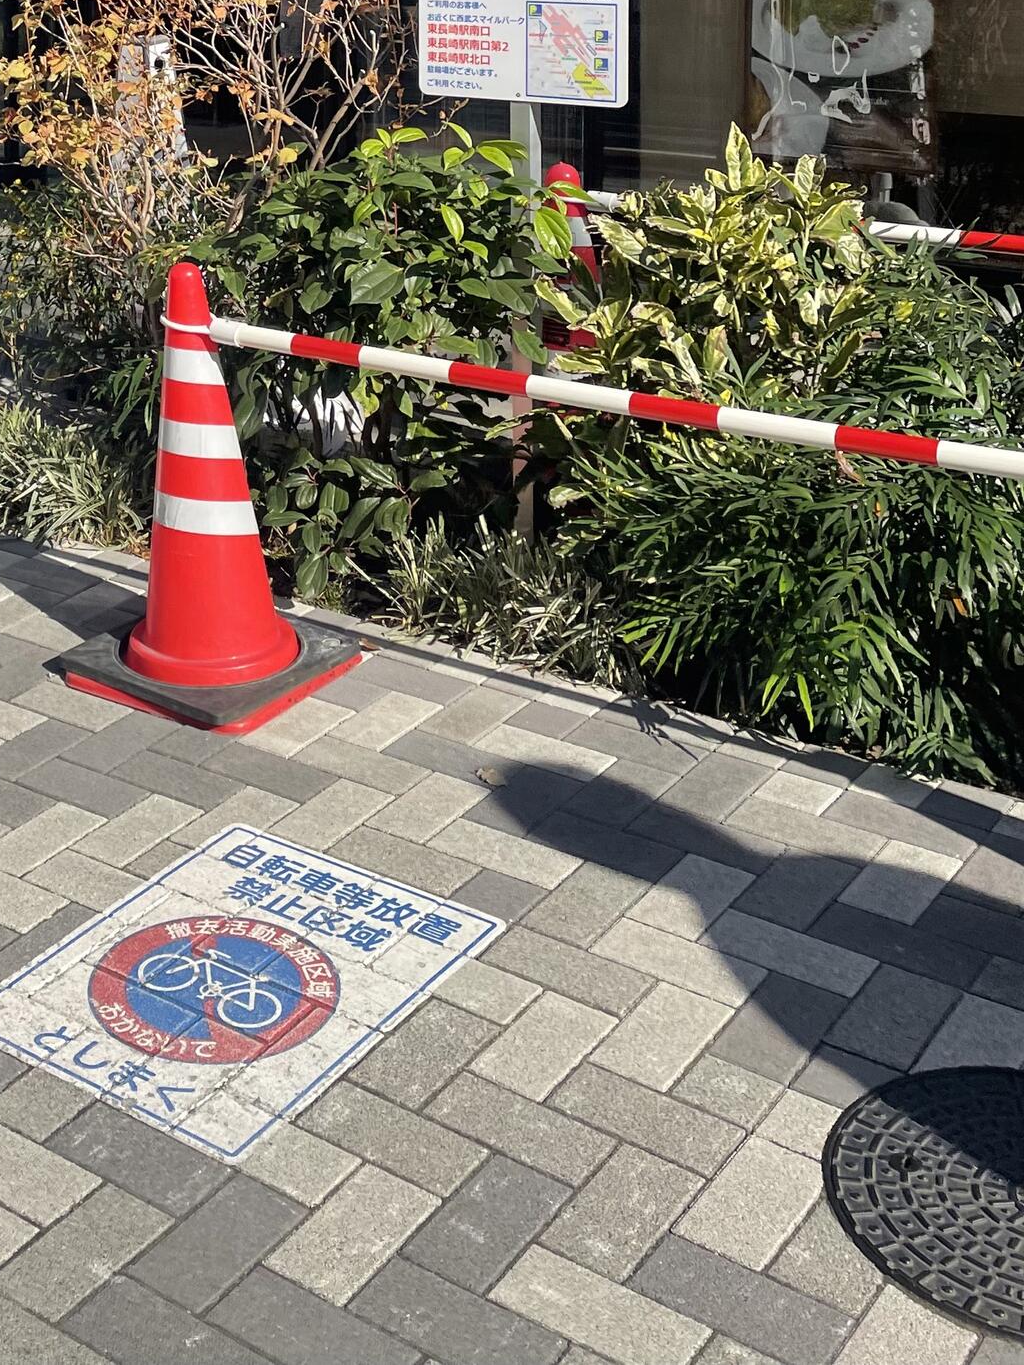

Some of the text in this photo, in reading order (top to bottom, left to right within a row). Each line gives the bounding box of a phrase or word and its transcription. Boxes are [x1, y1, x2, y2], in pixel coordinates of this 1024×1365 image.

[427, 23, 491, 37] 東長崎駅南口
[427, 37, 509, 52] 東長崎駅南口第2
[427, 51, 491, 65] 東長崎駅北口
[222, 843, 463, 946] 自転車等放置
[223, 876, 391, 952] 禁止区域
[164, 918, 337, 1000] 撤去活動実施区域
[97, 1001, 218, 1059] おかないで
[34, 1026, 195, 1113] としまく
